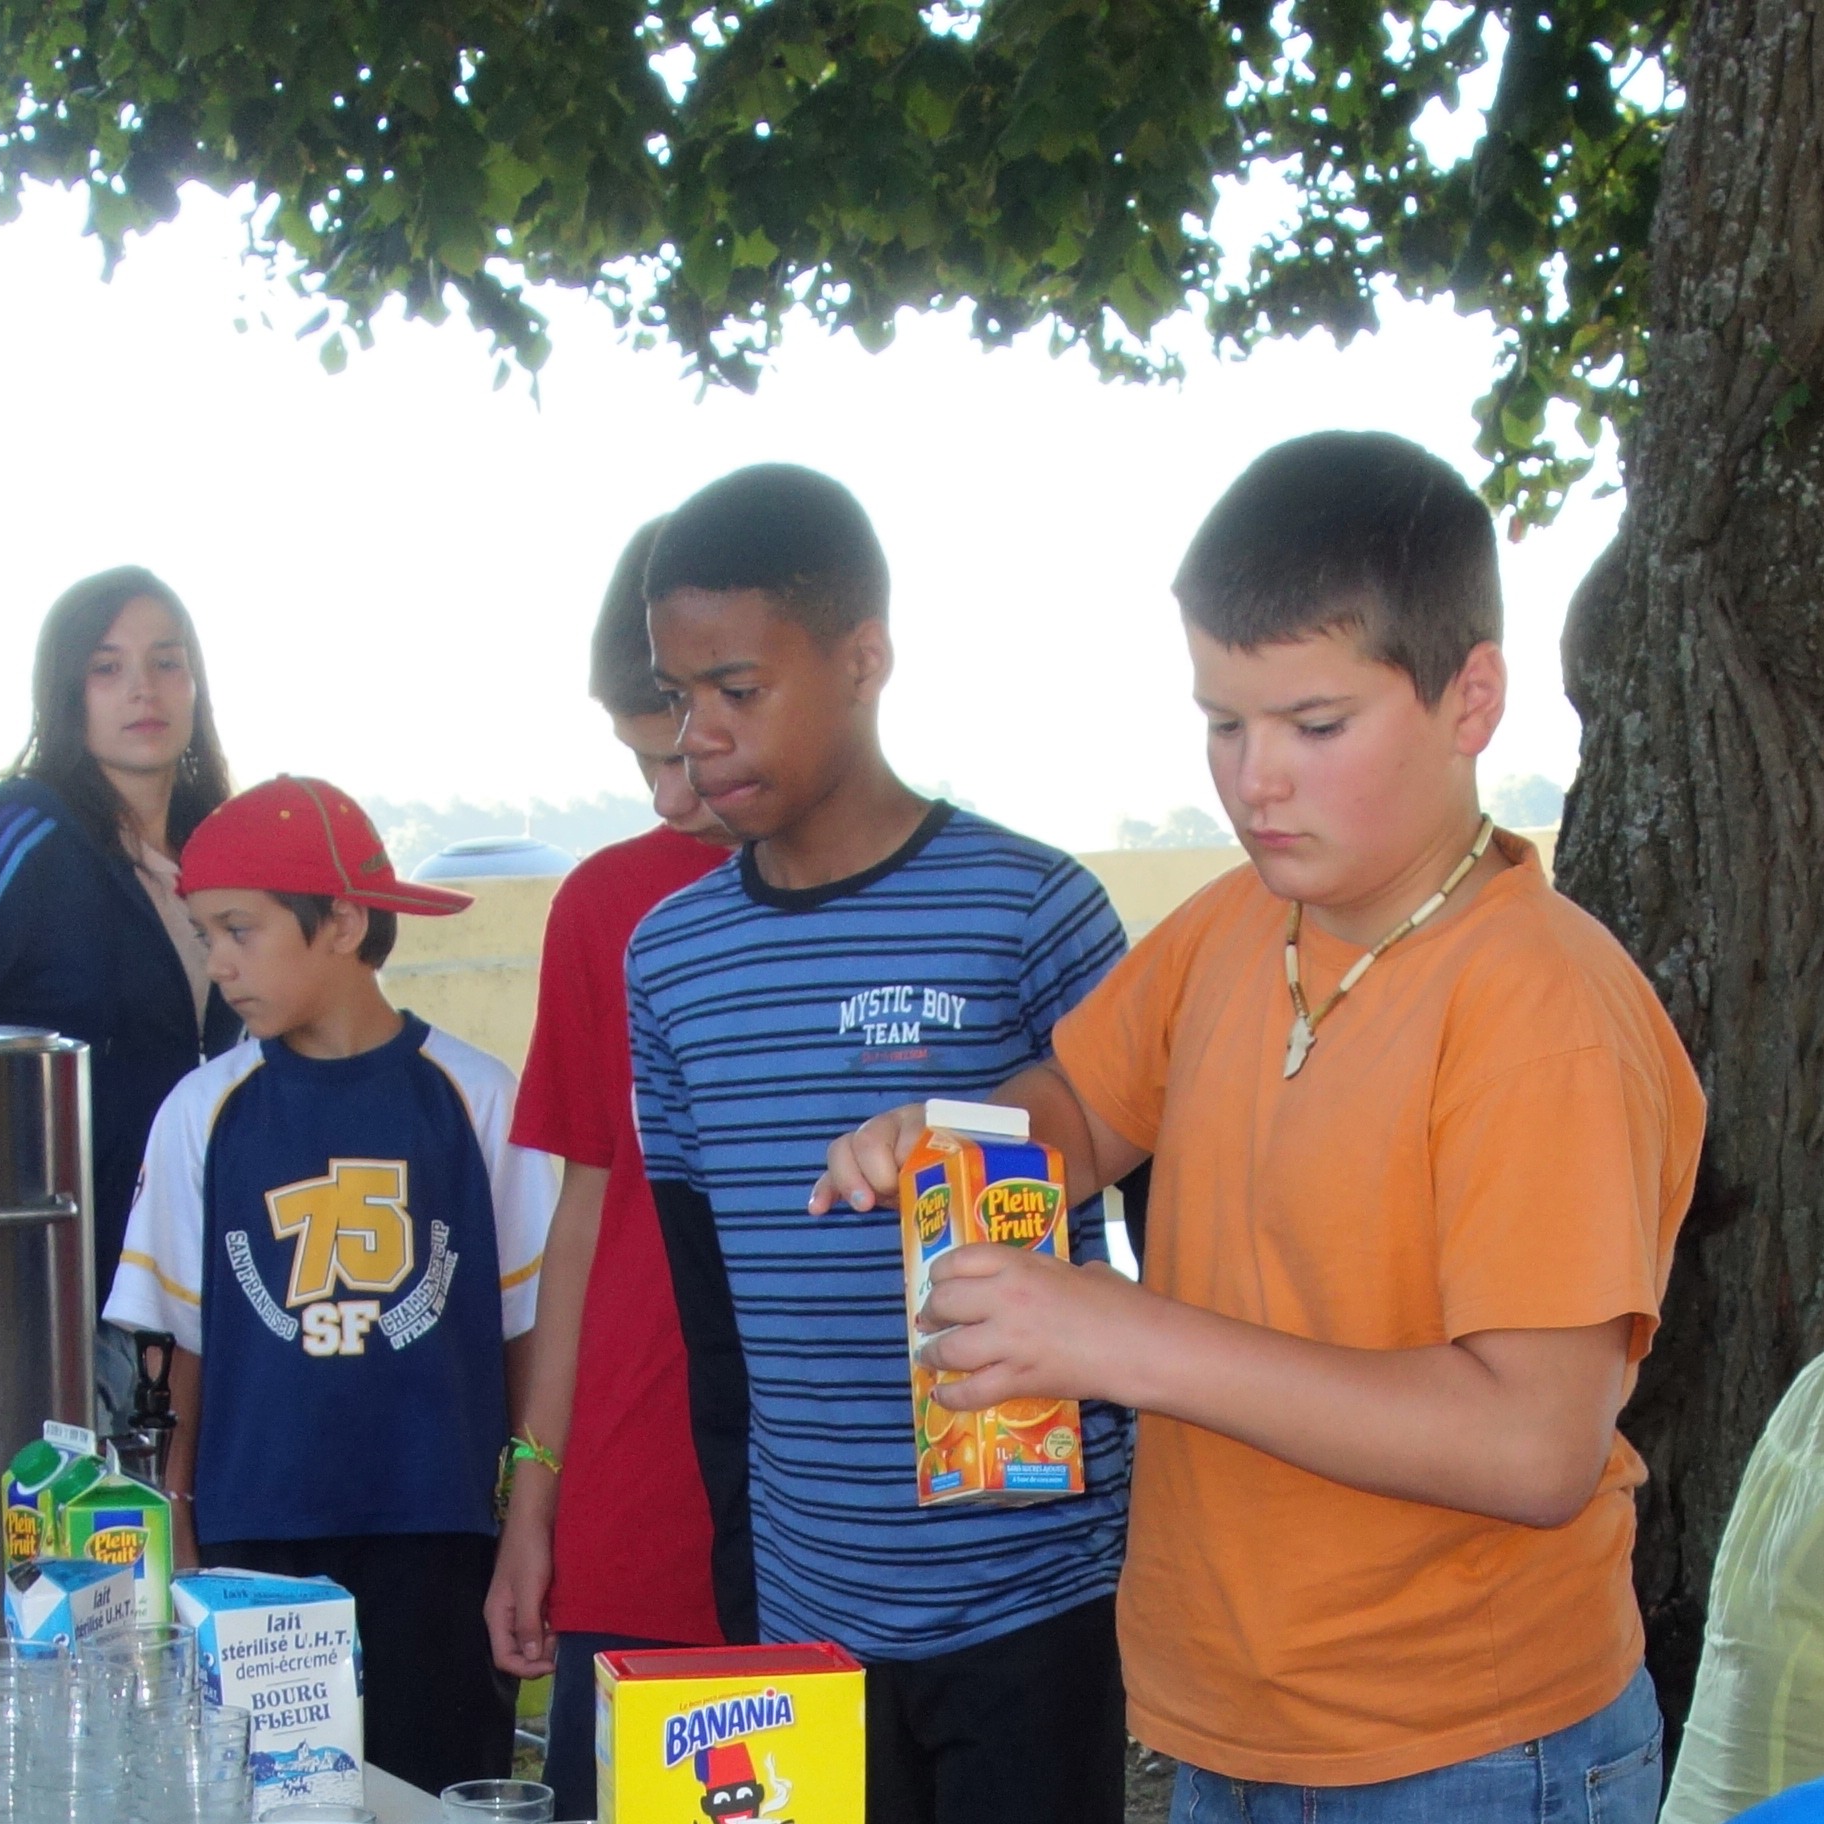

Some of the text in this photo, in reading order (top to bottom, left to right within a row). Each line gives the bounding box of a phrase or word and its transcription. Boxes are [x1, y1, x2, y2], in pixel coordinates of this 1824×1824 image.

[839, 985, 966, 1035] MYSTIC BOY
[863, 1021, 920, 1045] TEAM
[918, 1192, 945, 1220] Plein
[988, 1188, 1046, 1216] Plein
[264, 1157, 415, 1309] 75
[920, 1210, 946, 1240] Fruit
[989, 1213, 1047, 1243] Fruit
[225, 1230, 299, 1342] SAN FRANCISCO
[378, 1219, 450, 1336] CHALLENGE CUP
[302, 1300, 380, 1357] SF
[389, 1311, 438, 1351] OFFICIAL
[7, 1512, 37, 1535] Plein
[8, 1533, 37, 1556] Fruit
[94, 1532, 138, 1550] Plein
[95, 1548, 138, 1565] Fruit
[93, 1586, 111, 1609] lait
[267, 1612, 302, 1633] lait
[221, 1630, 351, 1662] stérilisé U.H.T.
[236, 1648, 338, 1680] demi-écrémé
[251, 1682, 328, 1710] BOURG
[254, 1703, 331, 1732] FLEURI
